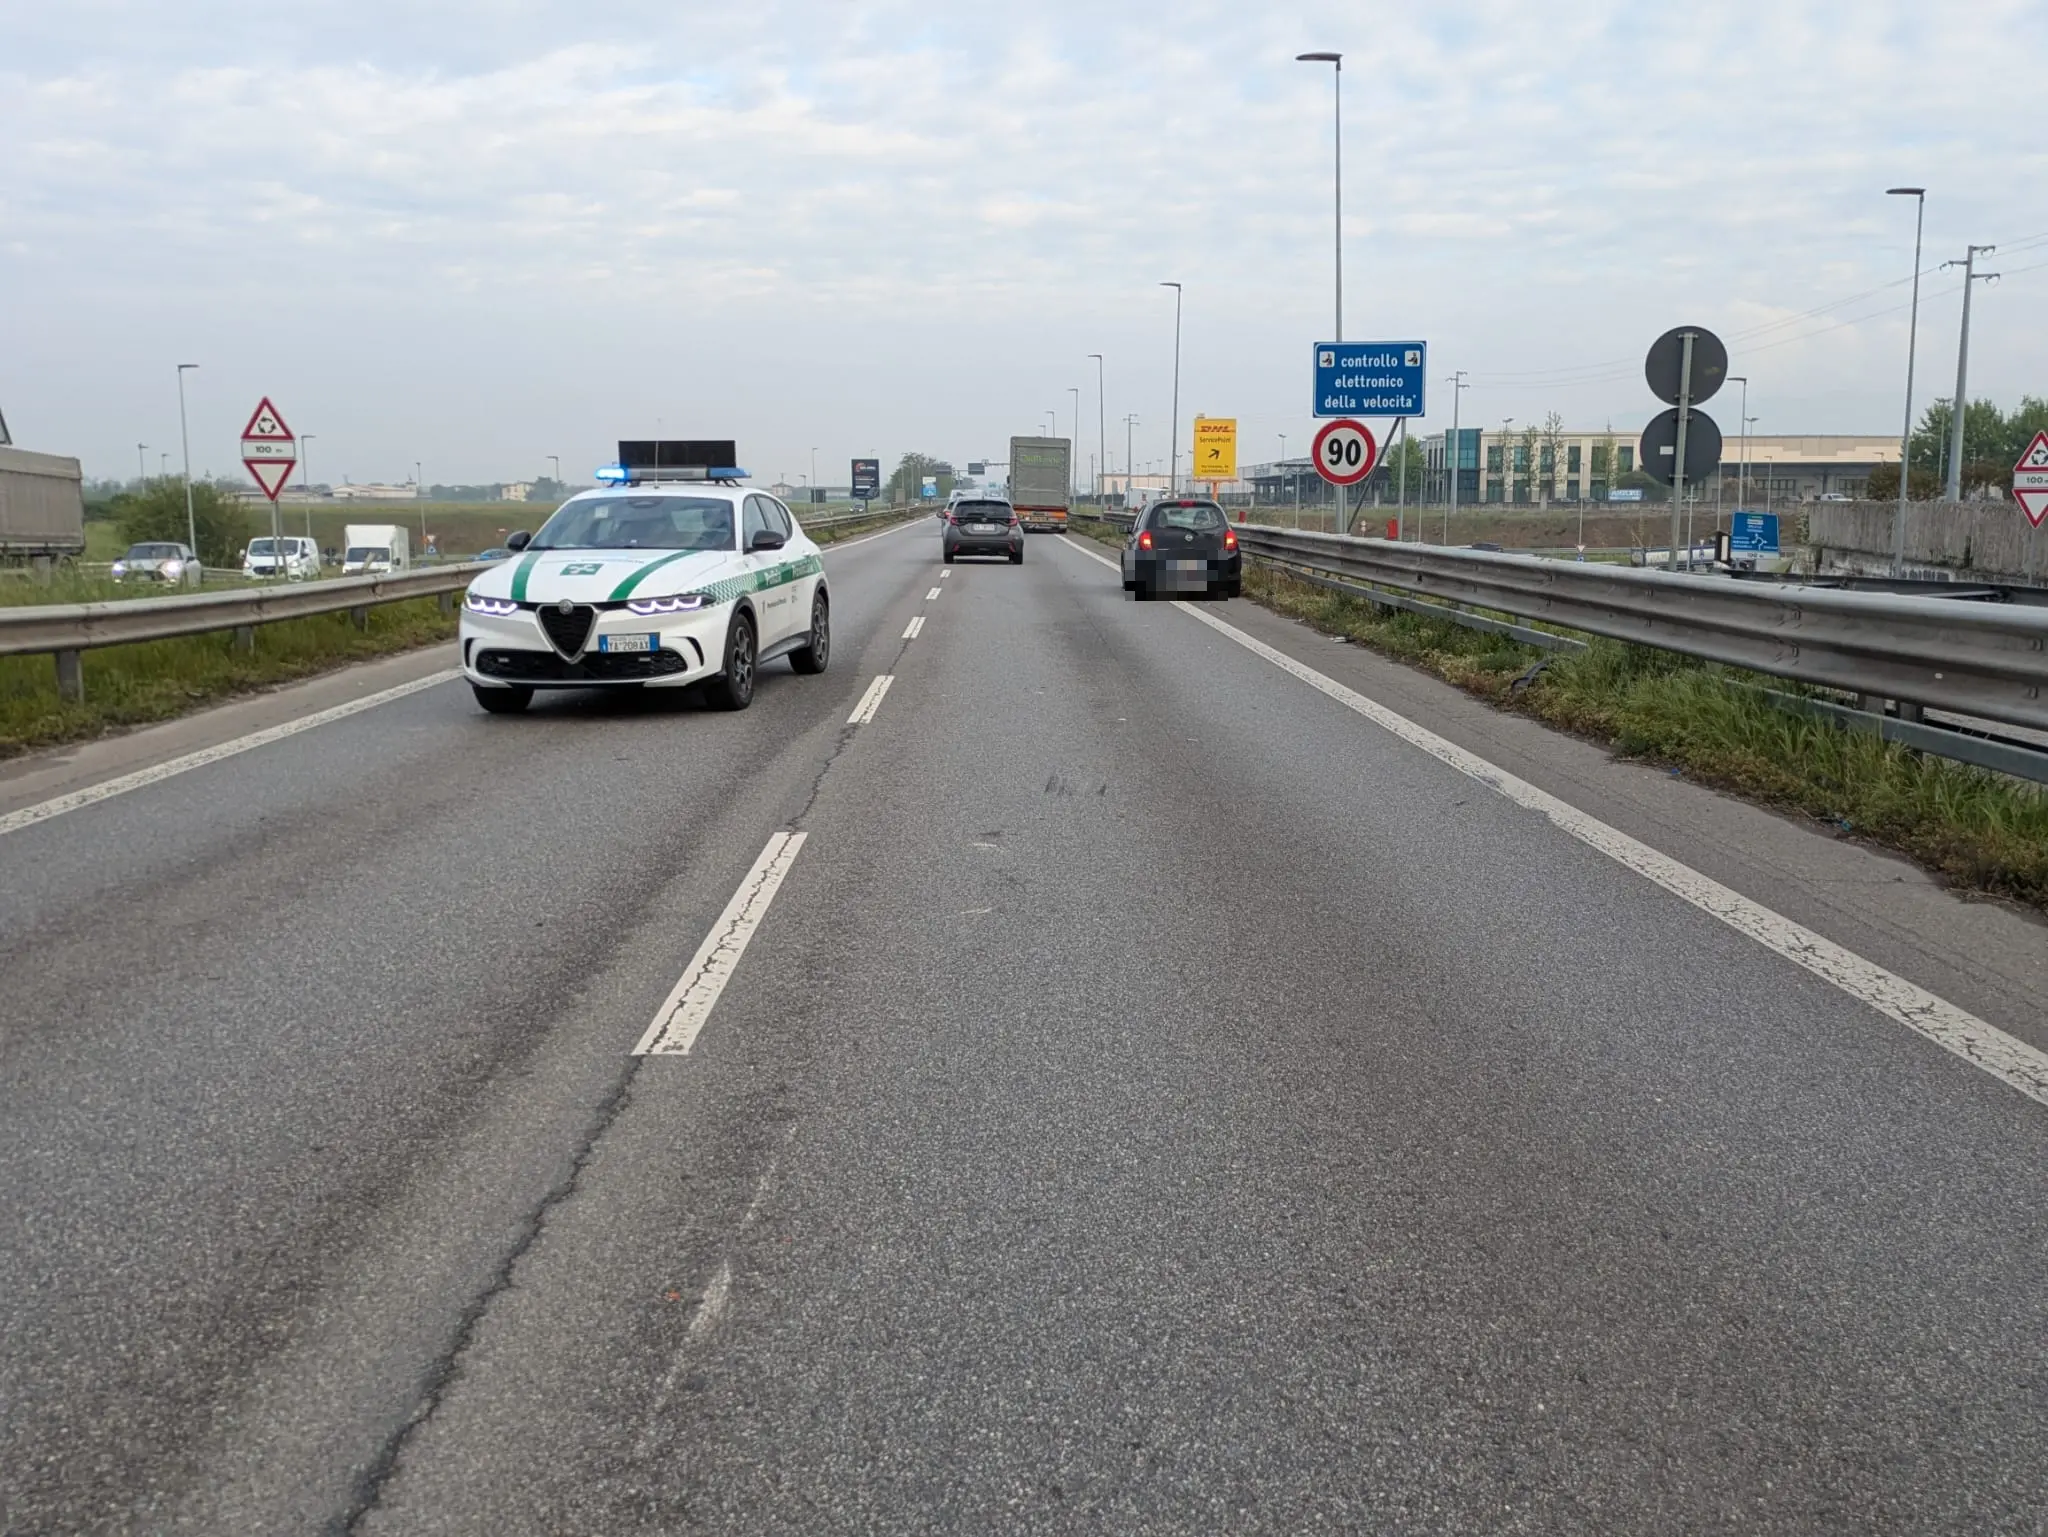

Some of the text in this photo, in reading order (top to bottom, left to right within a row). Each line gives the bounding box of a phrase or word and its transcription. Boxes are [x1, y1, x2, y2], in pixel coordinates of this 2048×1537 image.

[1341, 354, 1398, 367] controllo
[1334, 374, 1404, 388] elettronico
[1324, 395, 1356, 408] della
[255, 445, 272, 453] 100
[1328, 438, 1361, 466] 90
[2026, 476, 2043, 484] 100
